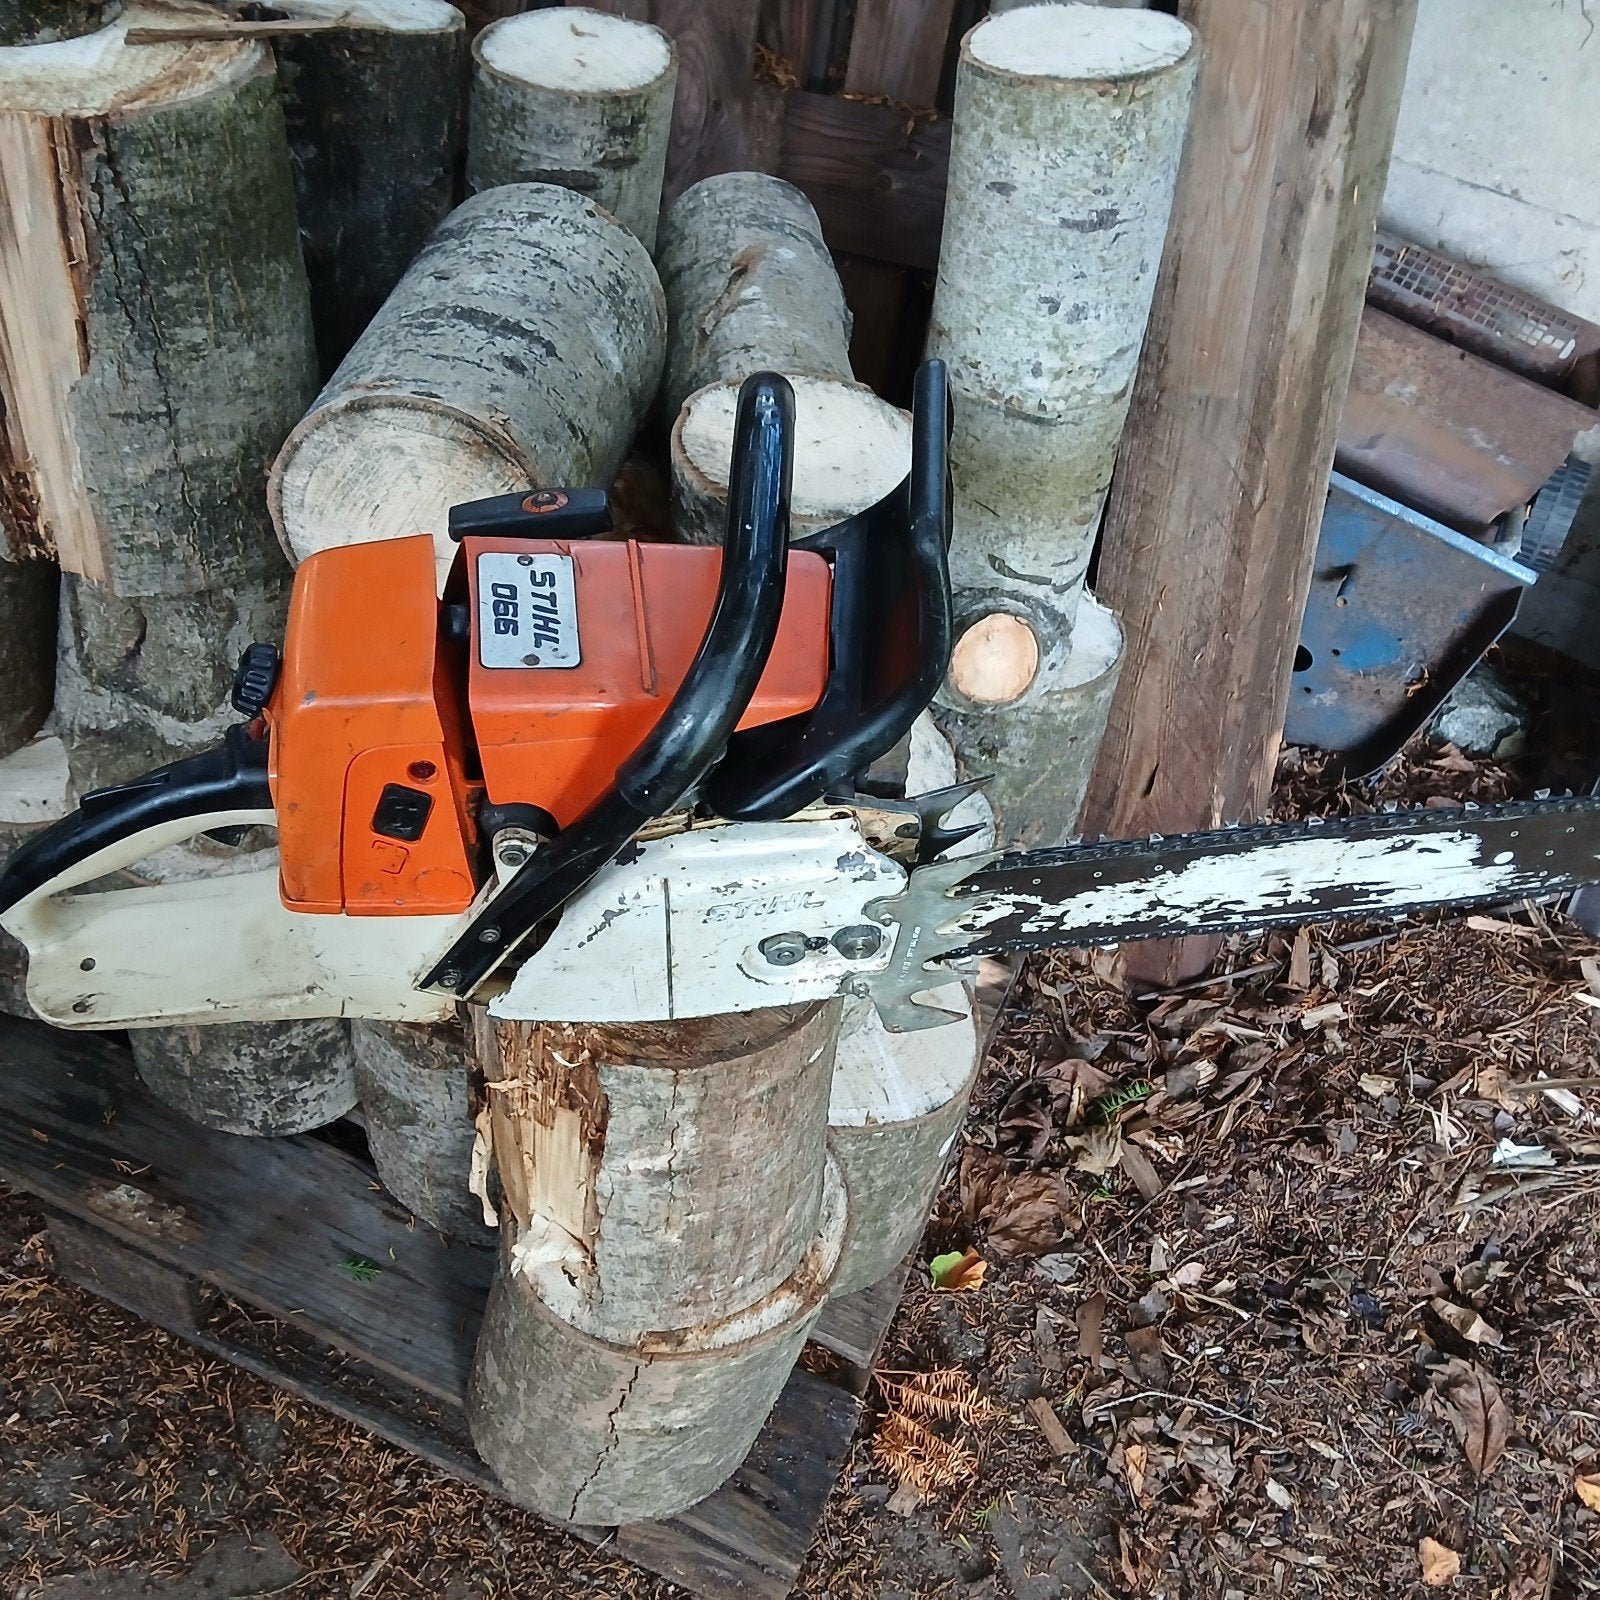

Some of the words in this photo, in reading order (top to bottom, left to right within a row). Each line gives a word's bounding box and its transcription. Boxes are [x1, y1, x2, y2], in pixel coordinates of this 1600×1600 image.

[491, 583, 519, 636] 066
[530, 570, 562, 648] STIHL
[703, 891, 826, 923] STIHL
